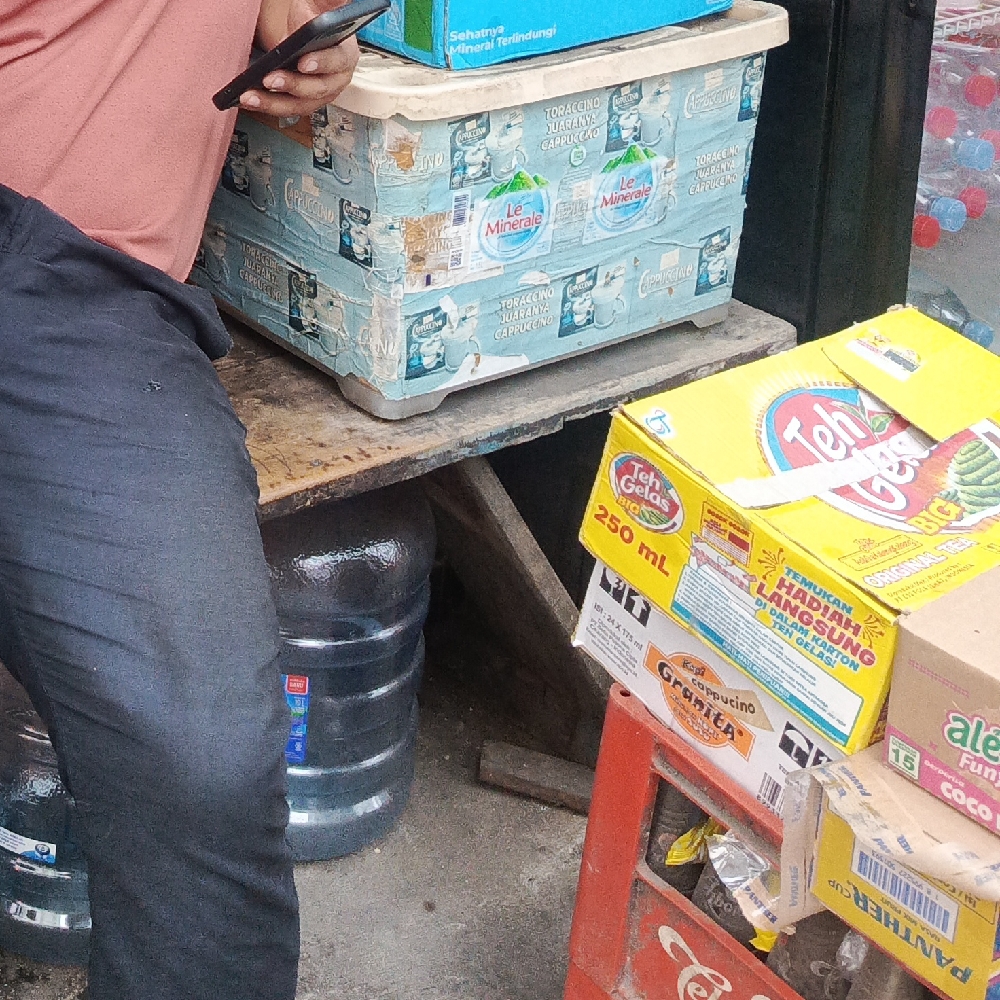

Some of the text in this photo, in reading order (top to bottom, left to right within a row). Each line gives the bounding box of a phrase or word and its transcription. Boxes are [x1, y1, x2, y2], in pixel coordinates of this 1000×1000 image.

[449, 24, 558, 55] Mineral Terlindungi
[450, 25, 505, 42] Sehatnya
[544, 96, 601, 121] TORACCINO
[684, 86, 738, 119] CAPPUCCINO
[541, 127, 601, 151] CAPPUCCINO
[546, 113, 597, 135] JUARANYA
[694, 144, 741, 167] TORACCINO
[694, 160, 735, 182] JUARANYA
[601, 184, 652, 209] Minerale
[620, 176, 636, 192] Le
[688, 173, 739, 196] CAPPUCCINO
[484, 212, 543, 237] Minerale
[506, 203, 523, 219] Le
[638, 263, 695, 300] CAPPUCCINO
[500, 287, 555, 312] TORACCINO
[500, 303, 550, 324] JUARANYA
[494, 315, 554, 341] CAPPUCCINO
[782, 402, 868, 464] Teh
[630, 460, 662, 492] Teh
[617, 495, 642, 517] BIG
[619, 475, 671, 513] Gelas
[904, 496, 965, 536] BIG
[594, 504, 635, 545] 250
[637, 541, 671, 578] mL
[863, 551, 948, 589] ORIGINAL
[934, 537, 979, 557] TEA
[785, 566, 854, 615] TEMUKAN
[776, 576, 862, 637] HADIAH
[606, 612, 616, 624] 24
[622, 625, 634, 643] 175
[633, 639, 643, 651] ml
[754, 598, 767, 610] DI
[769, 604, 810, 638] DALAM
[812, 634, 860, 672] KARTON
[756, 581, 876, 667] LANGSUNG
[795, 636, 837, 669] GELAS!
[691, 676, 756, 715] cappucino
[891, 748, 916, 773] 15
[940, 780, 993, 822] COCO
[827, 878, 974, 985] PANTHER CUP
